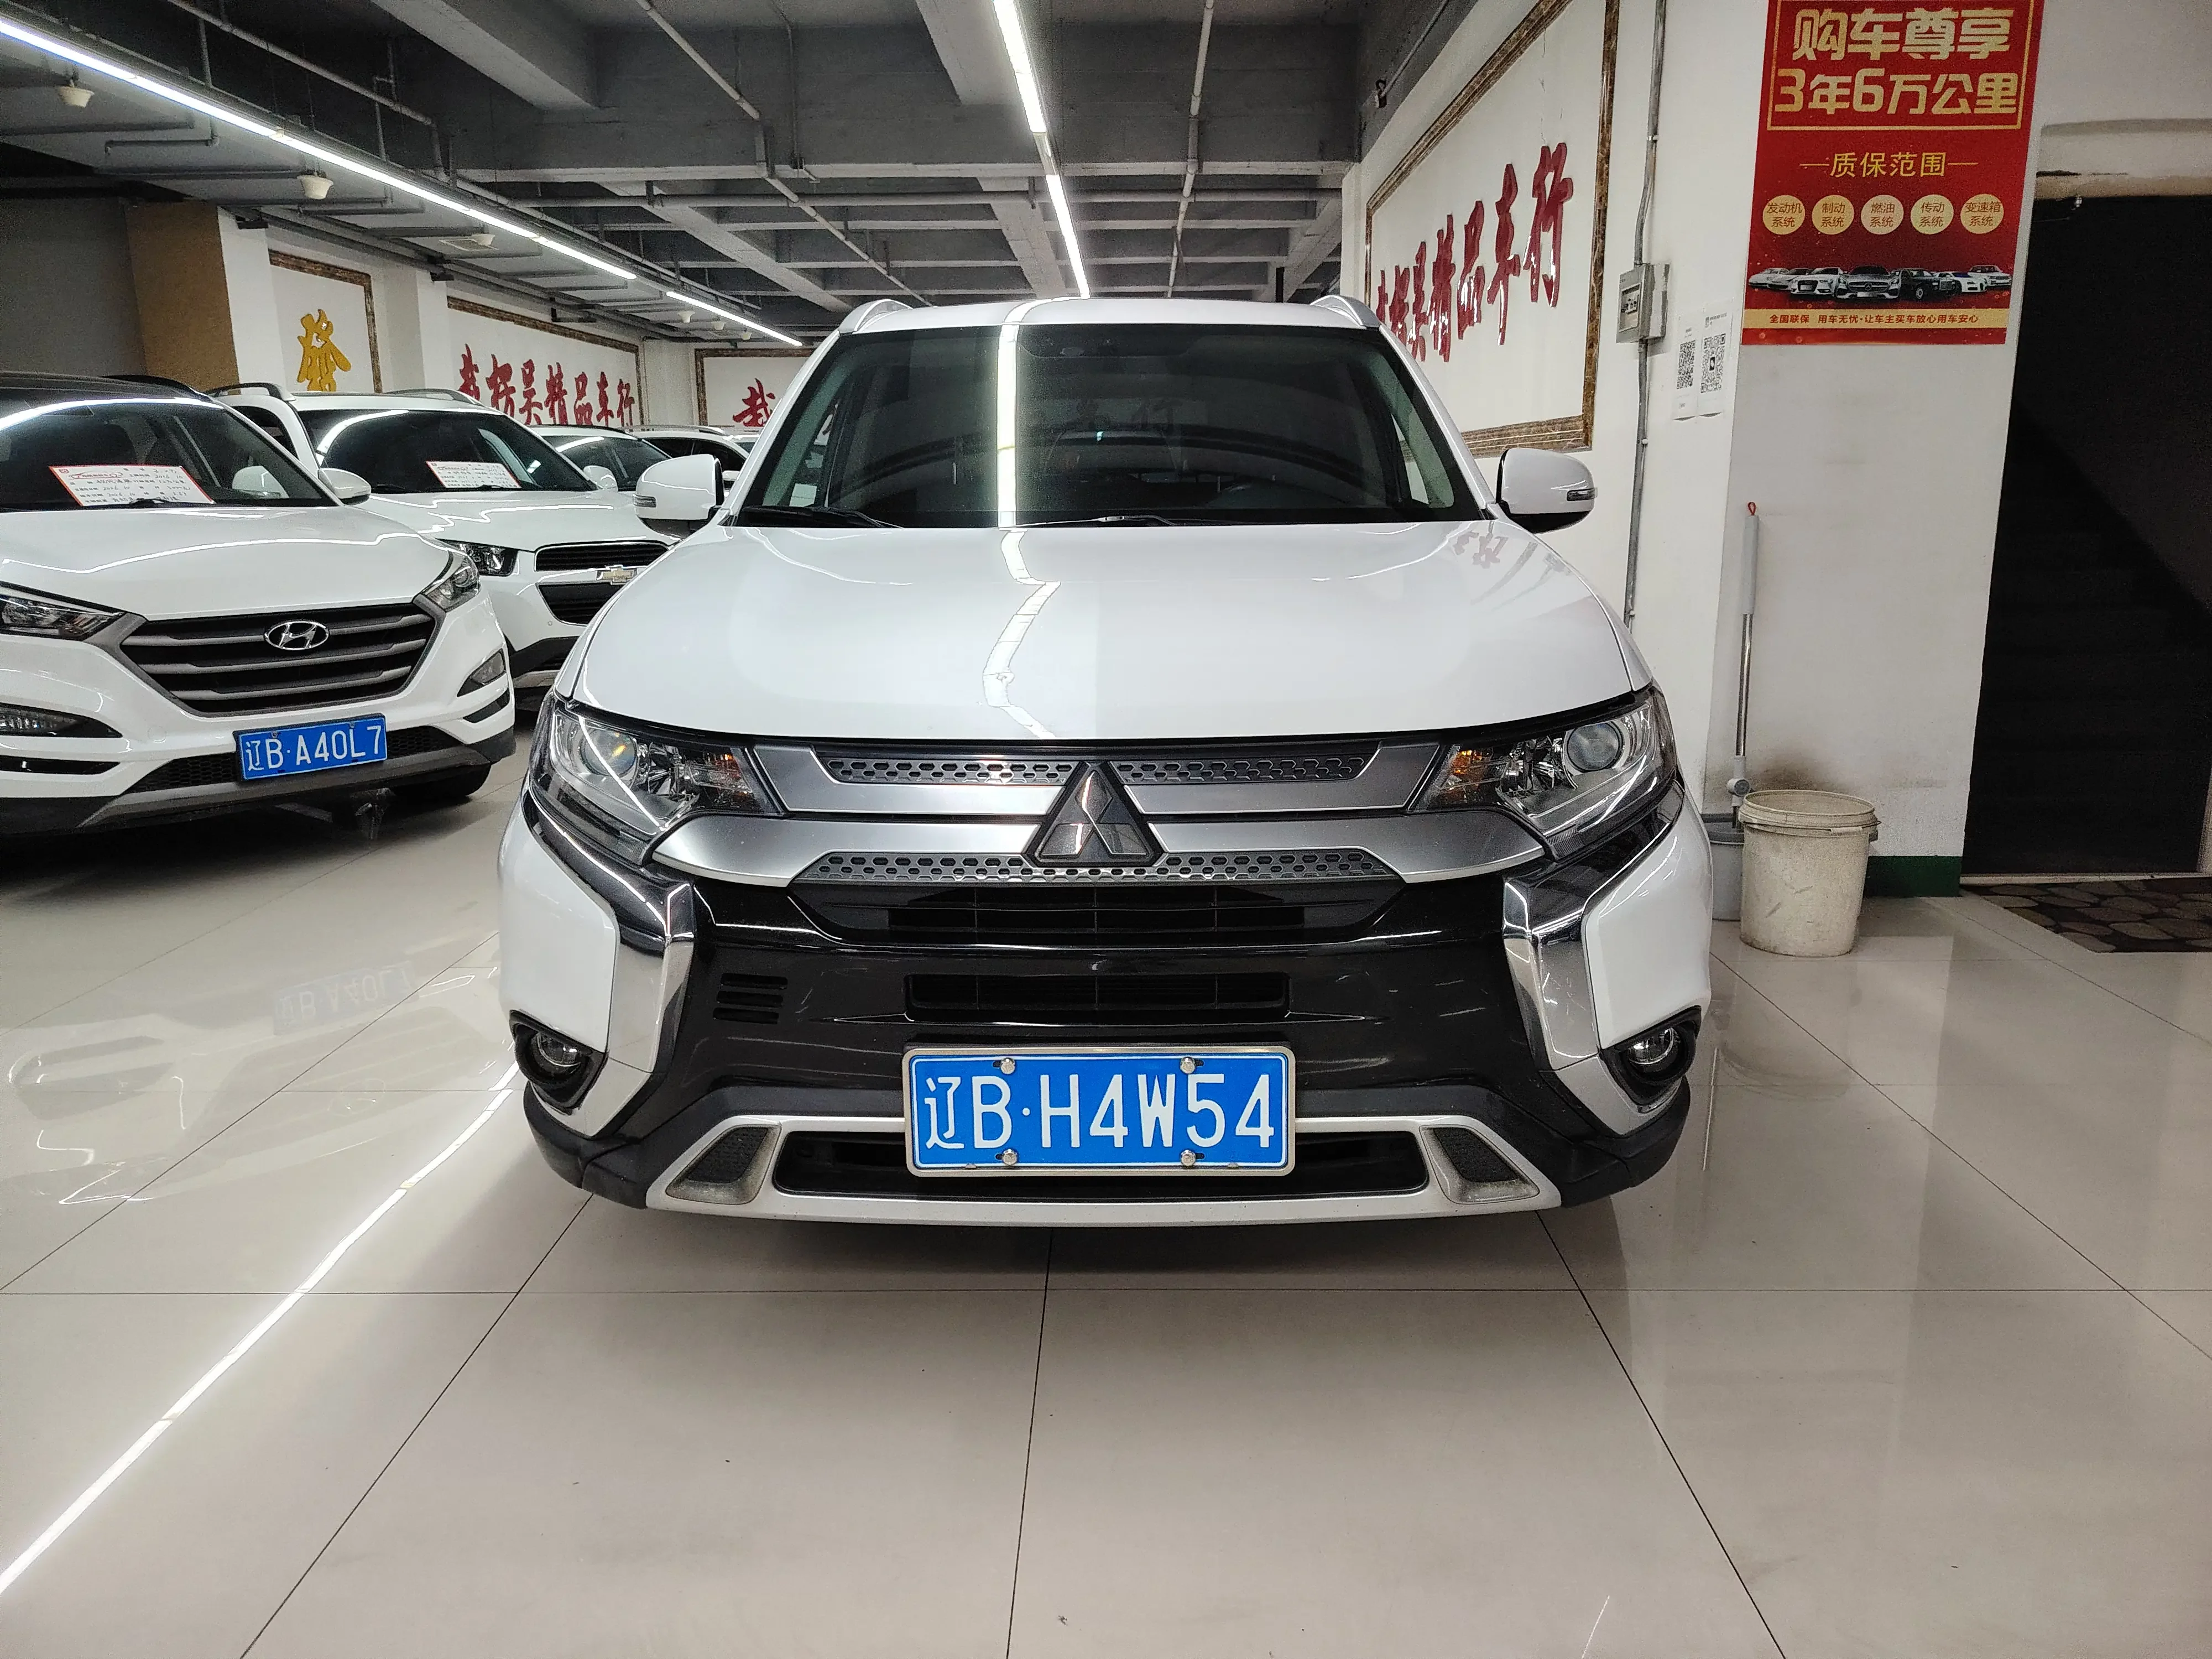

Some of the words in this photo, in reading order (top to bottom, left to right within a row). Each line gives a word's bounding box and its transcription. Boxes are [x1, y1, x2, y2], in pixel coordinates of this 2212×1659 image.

[1792, 7, 2014, 61] 购车尊享
[1774, 68, 2018, 114] 3年6万公里
[1829, 152, 1947, 178] 质保范围
[1767, 202, 1803, 214] 发动机
[1822, 202, 1845, 213] 制动
[1870, 202, 1895, 213] 燃油
[1921, 202, 1945, 213] 传动
[1965, 201, 2001, 213] 变速箱
[1771, 216, 1796, 228] 系统
[1820, 216, 1844, 228] 系统
[1869, 216, 1894, 228] 系统
[1919, 216, 1944, 228] 系统
[1969, 216, 1994, 228] 系统
[1770, 314, 1809, 324] 全国联保
[246, 725, 382, 771] 辽B·A40L7
[924, 1073, 1275, 1150] 辽B·H4W54
